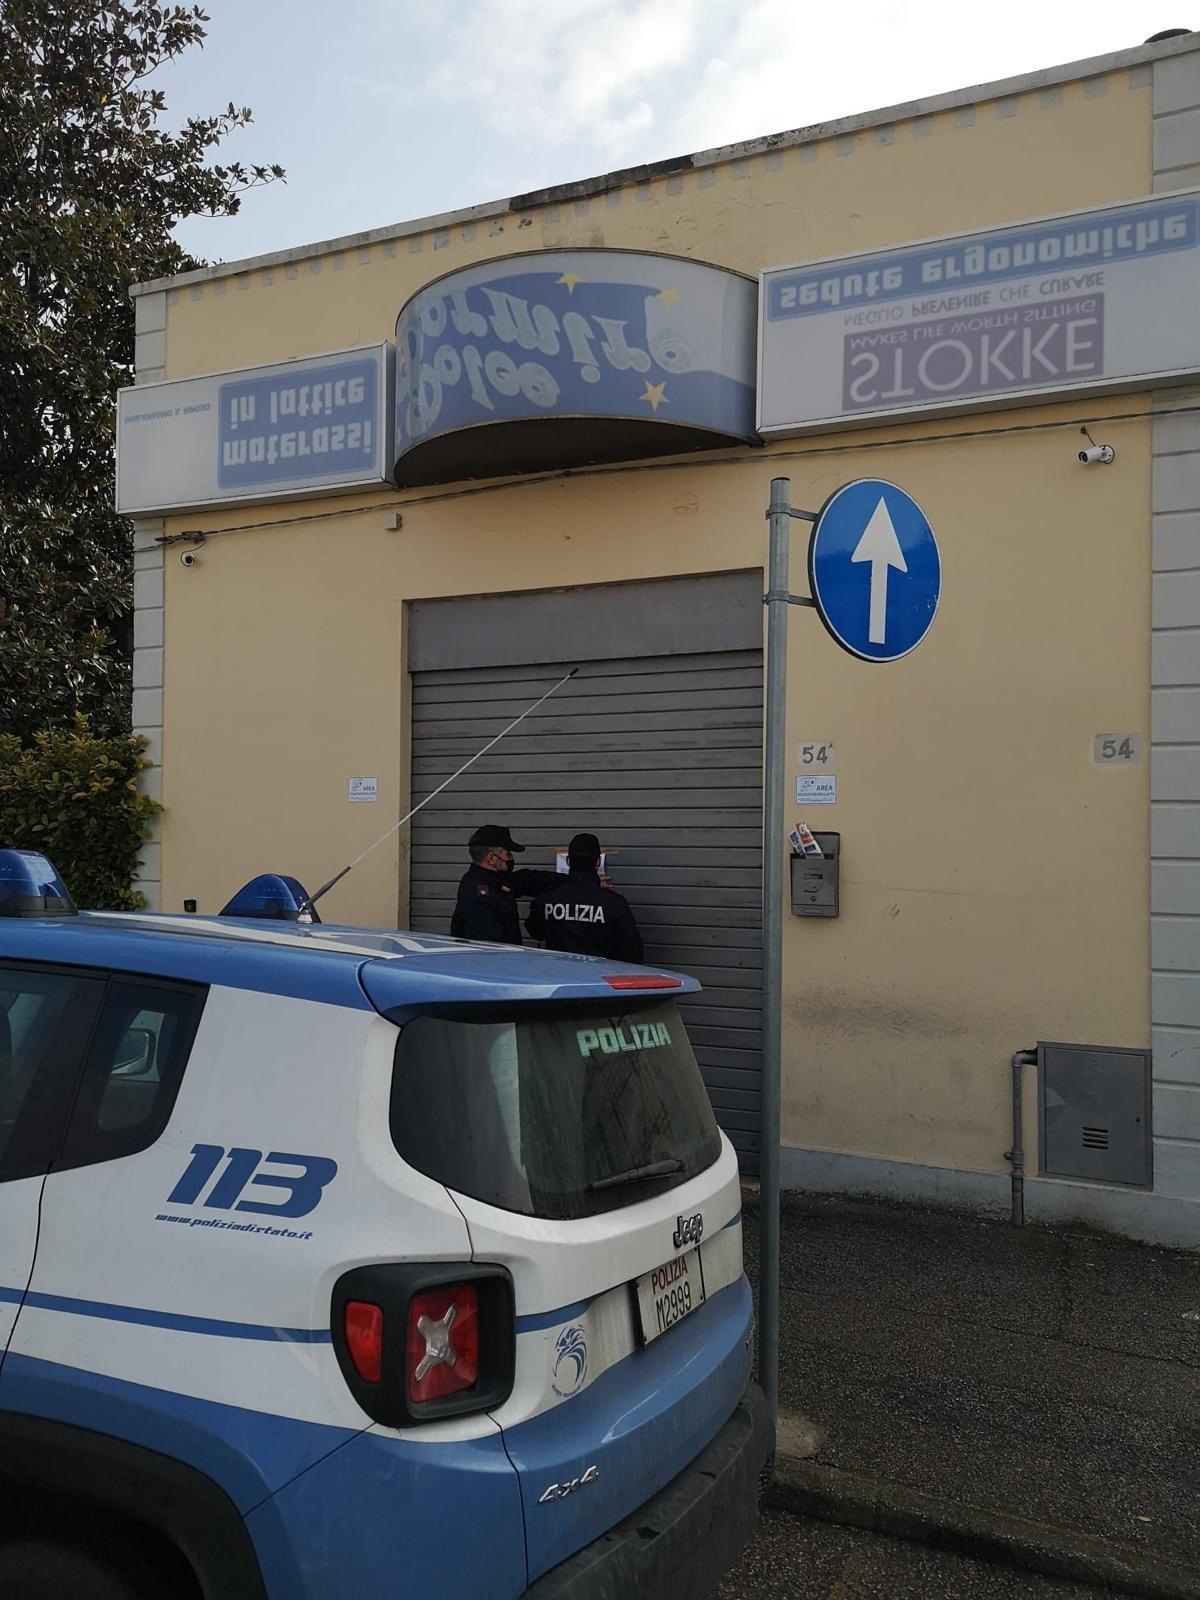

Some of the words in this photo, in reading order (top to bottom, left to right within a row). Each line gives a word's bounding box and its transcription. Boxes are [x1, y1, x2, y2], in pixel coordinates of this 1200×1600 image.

[1102, 737, 1135, 759] 54
[544, 903, 606, 924] POLIZIA
[576, 1022, 672, 1057] POLIZIA
[166, 1143, 338, 1219] 113
[154, 1213, 314, 1241] www.poliziadistato.it
[673, 1213, 704, 1249] Jeep
[651, 1255, 689, 1295] POLIZIA
[655, 1280, 692, 1333] M2999
[538, 1464, 600, 1504] 4x4
